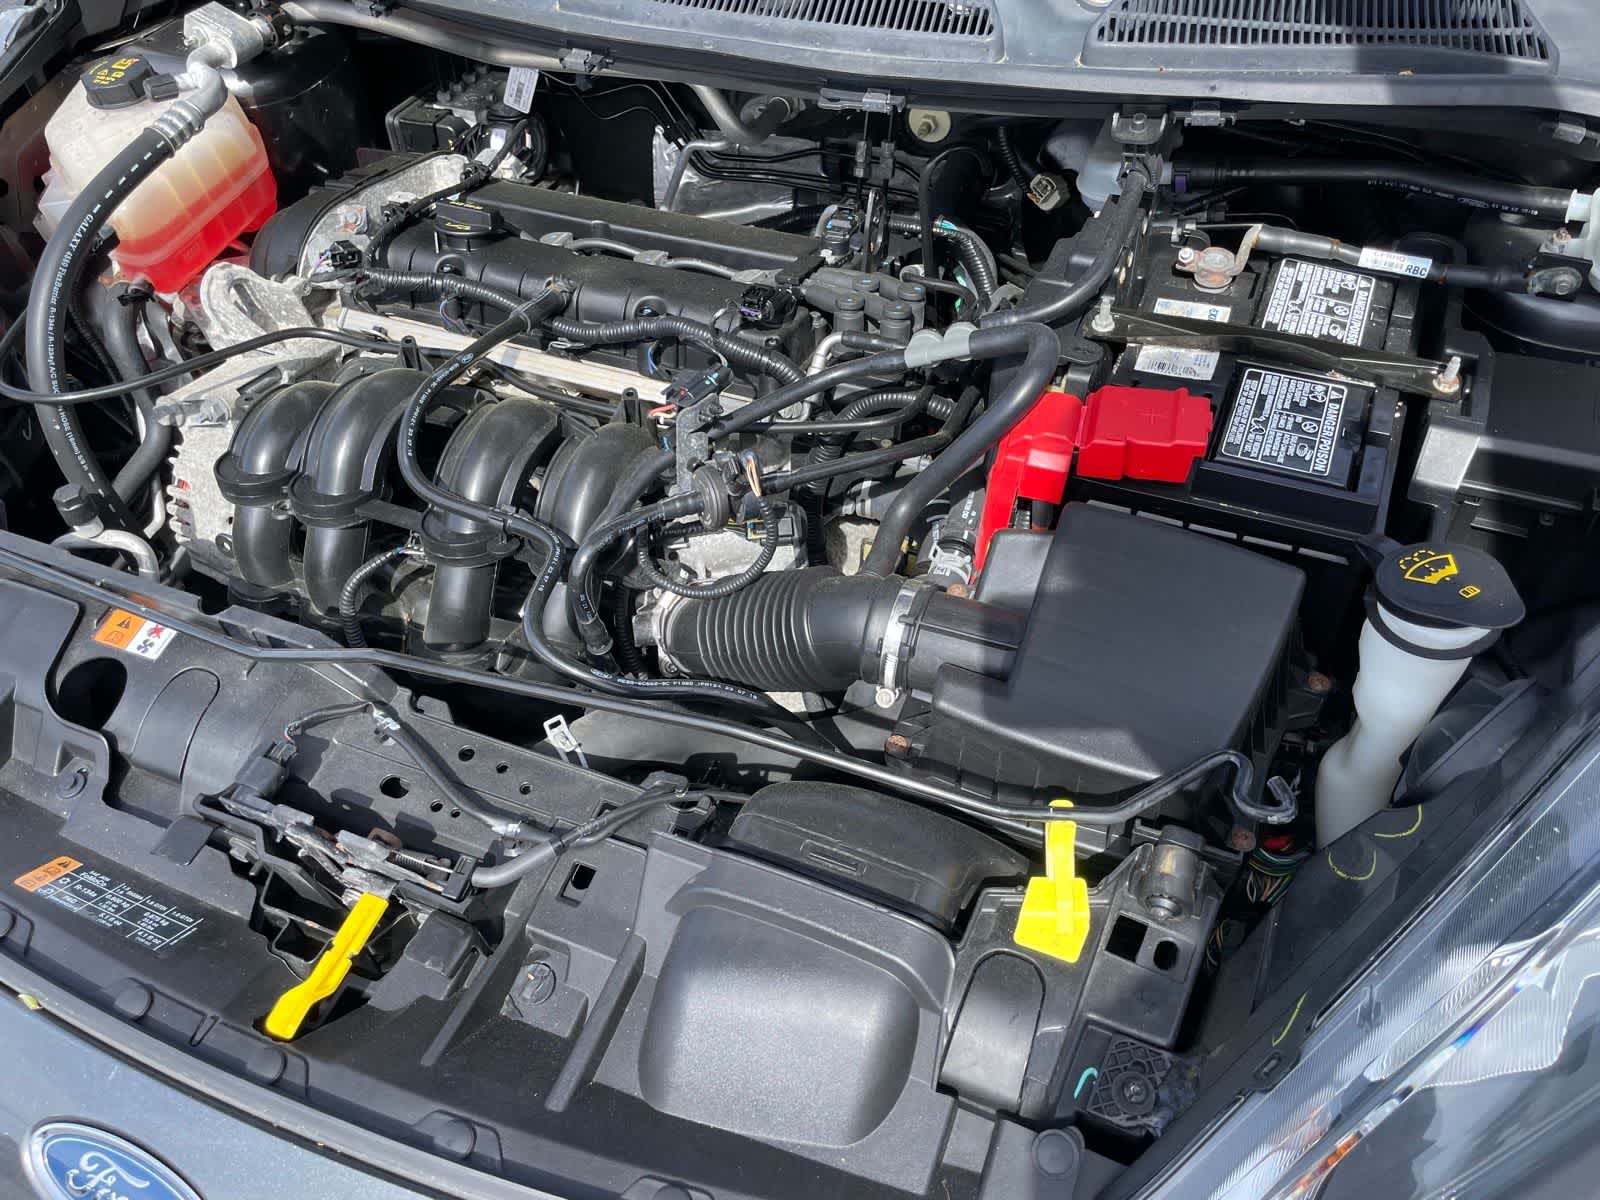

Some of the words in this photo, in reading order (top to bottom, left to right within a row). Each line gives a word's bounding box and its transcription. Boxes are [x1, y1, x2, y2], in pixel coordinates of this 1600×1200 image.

[70, 214, 94, 250] GALAXY
[1404, 264, 1427, 276] RBC
[1313, 402, 1340, 471] DANGER/POISON
